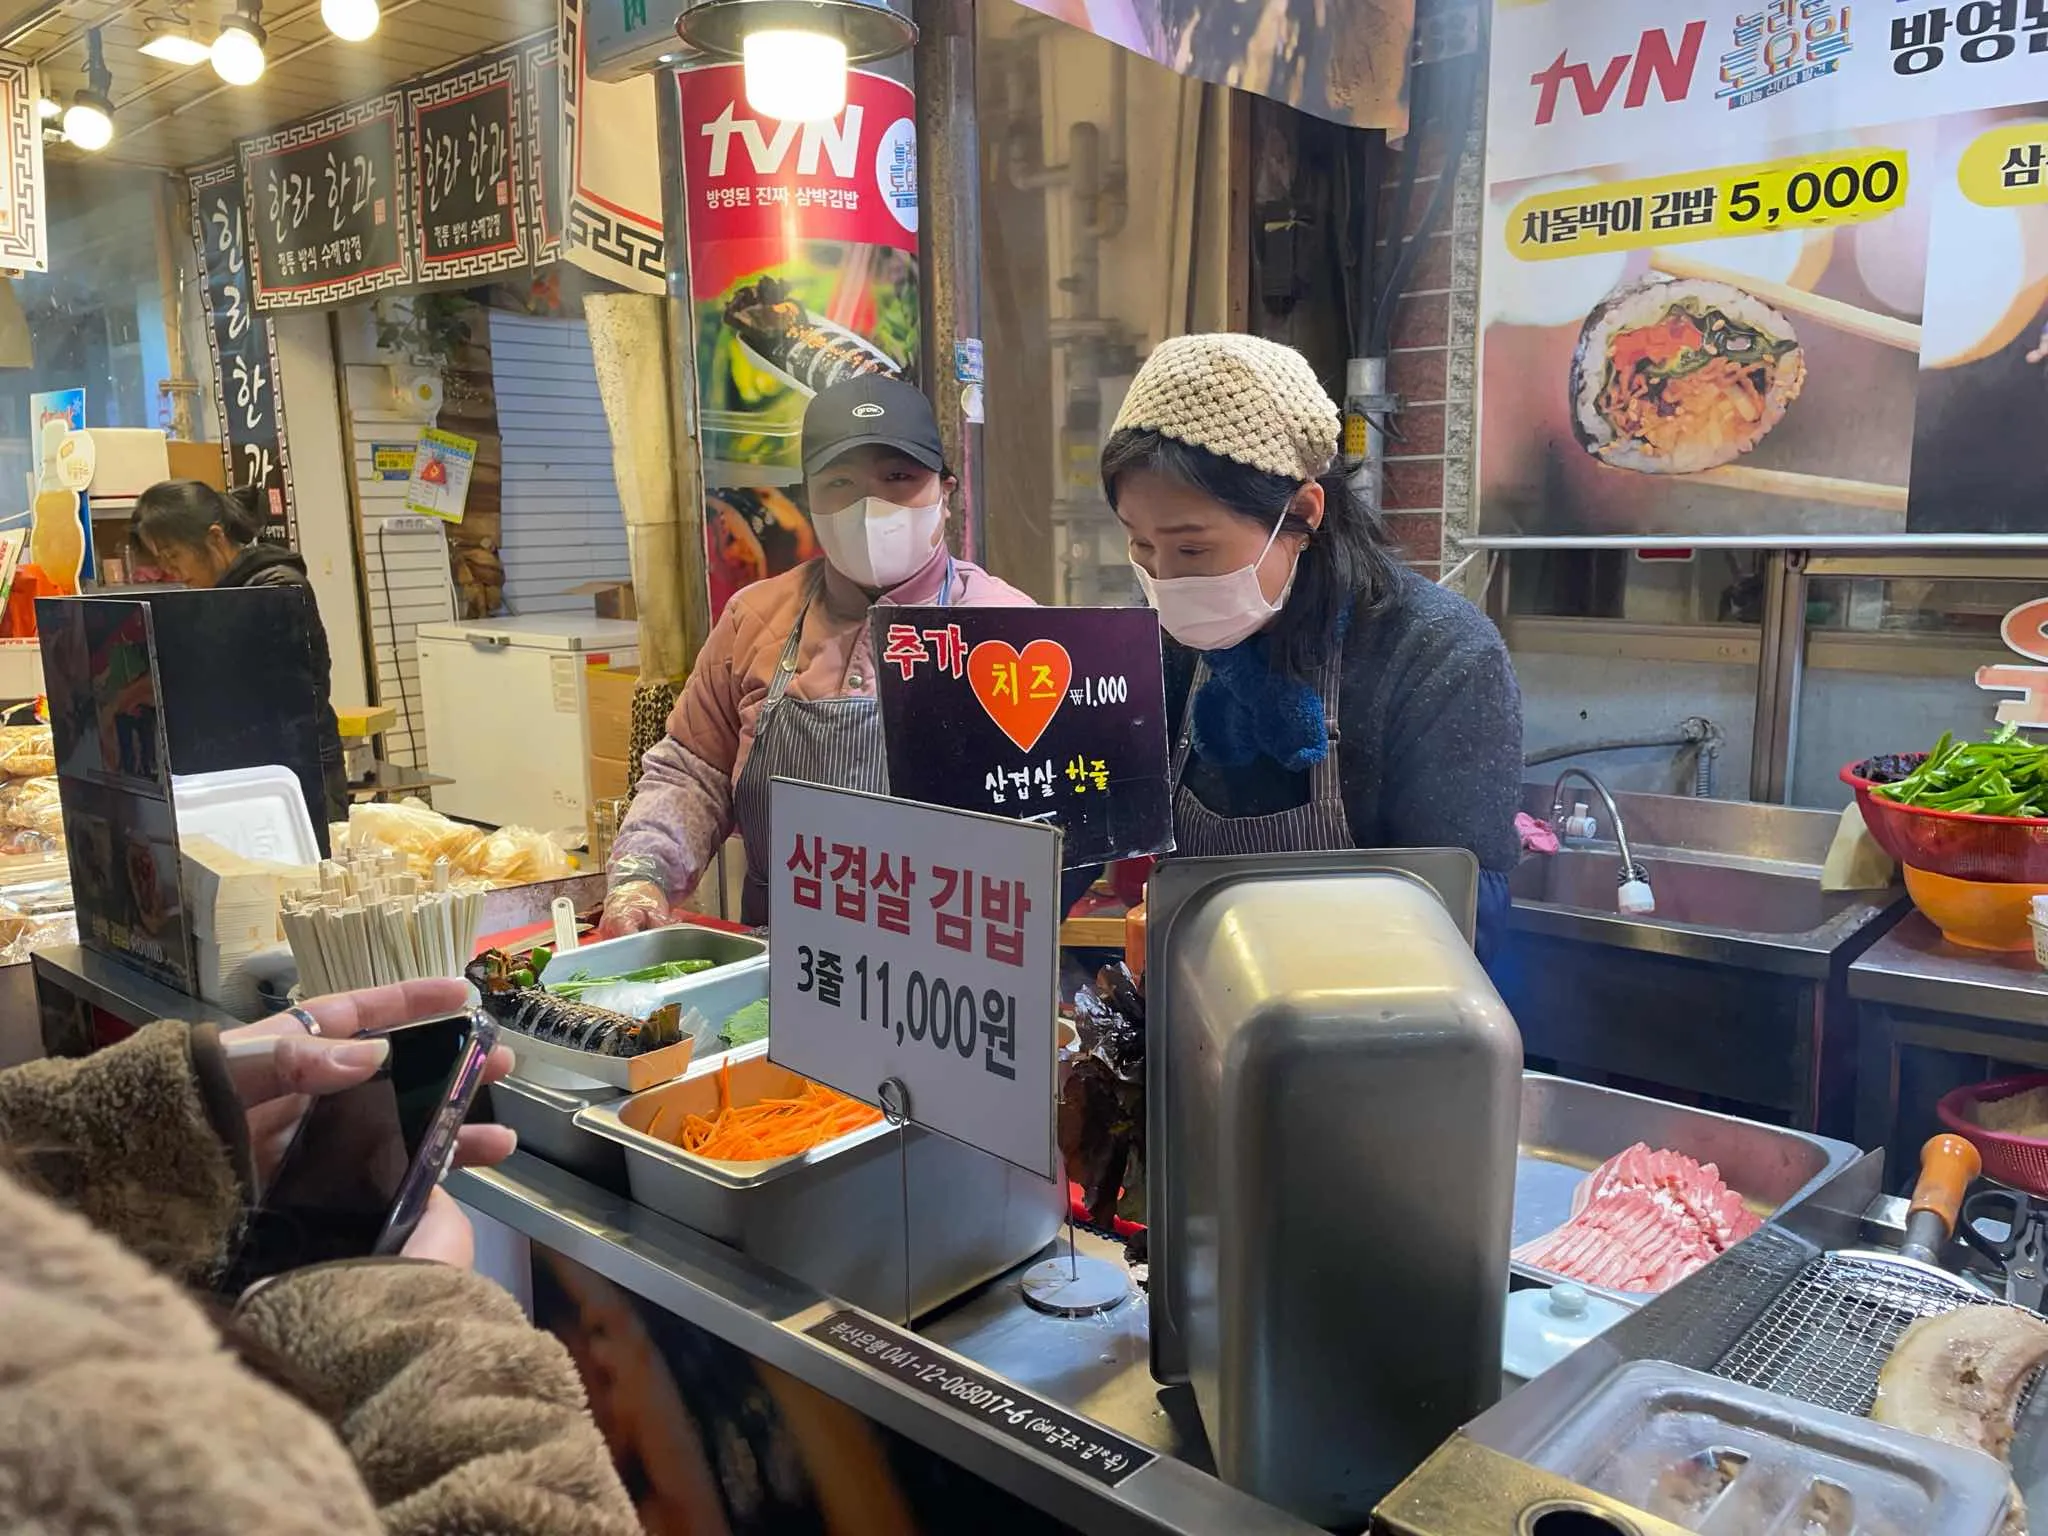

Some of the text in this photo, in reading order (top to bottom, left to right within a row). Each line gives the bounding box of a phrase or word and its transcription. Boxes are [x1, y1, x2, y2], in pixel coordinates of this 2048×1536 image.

[1531, 20, 1707, 126] tvN
[1715, 6, 1853, 99] 토요일
[424, 113, 508, 213] 한라 한과
[701, 99, 864, 179] tvN
[268, 152, 377, 244] 한라 한과
[706, 186, 859, 210] 방영된 진짜 삼박김밥
[1520, 160, 1899, 245] 차돌박이 김밥 5,000
[321, 235, 362, 269] 수제강정
[885, 624, 968, 681] 추가
[991, 662, 1057, 705] 치즈
[985, 760, 1057, 804] 삼겹살
[786, 833, 1032, 968] 삼겹살 김밥
[797, 945, 1016, 1081] 3줄 11,000원
[829, 1322, 891, 1354] 부산은행
[879, 1346, 1034, 1424] 041-12-068017-6
